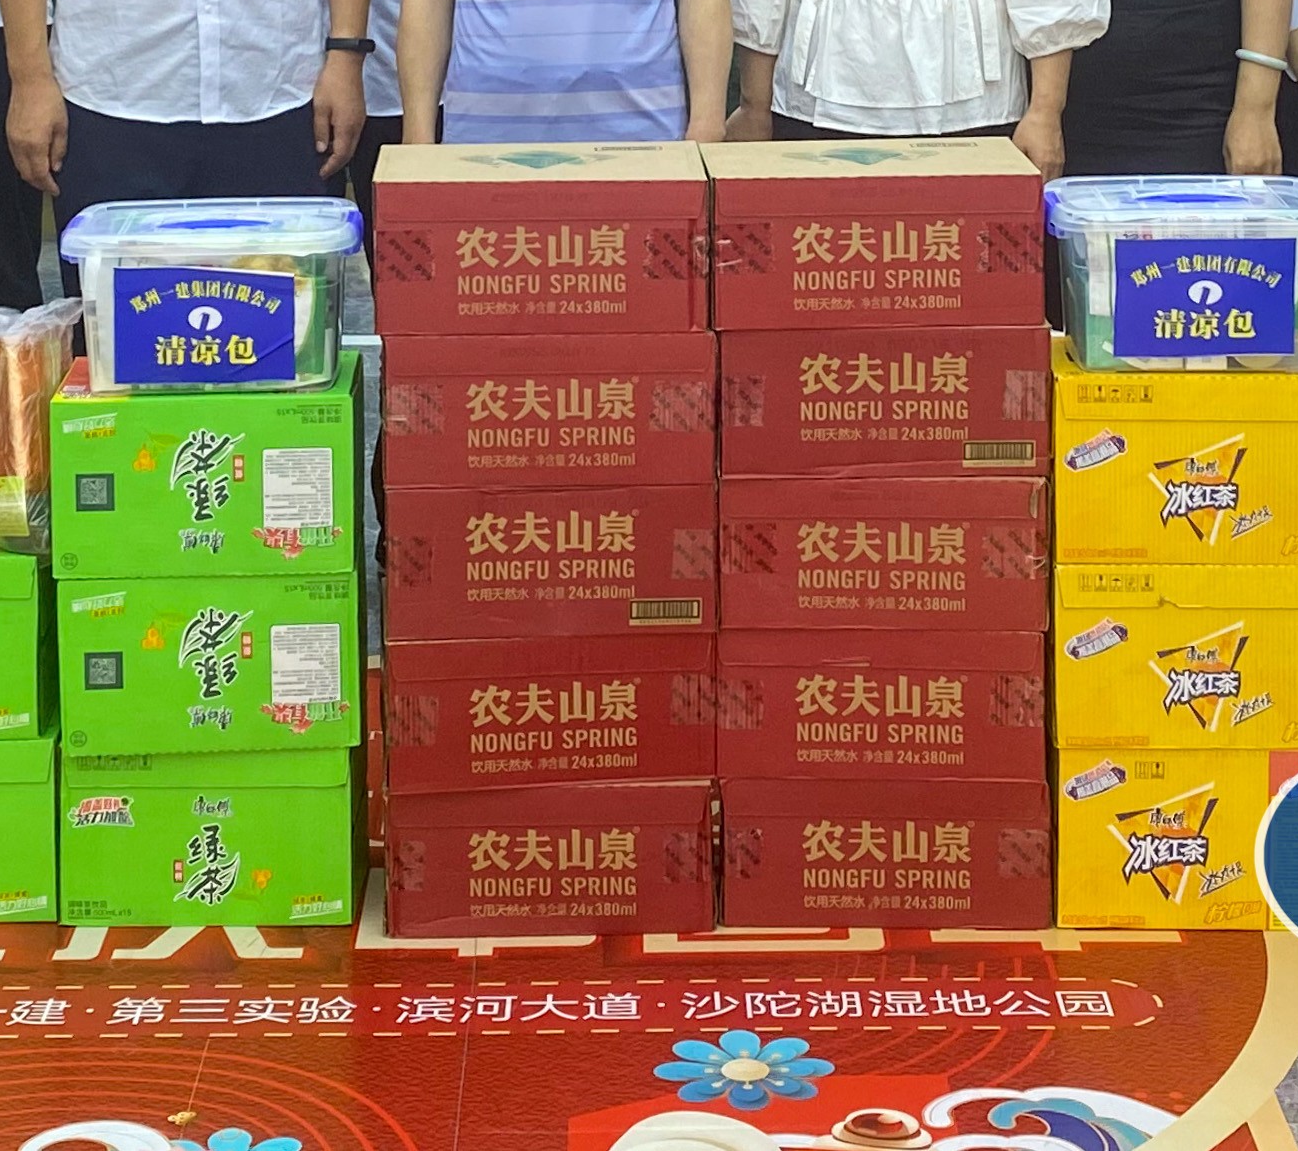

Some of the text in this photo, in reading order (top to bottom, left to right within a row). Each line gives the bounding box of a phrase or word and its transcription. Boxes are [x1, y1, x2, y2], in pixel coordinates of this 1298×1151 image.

[456, 224, 627, 269] 农夫山泉
[792, 220, 962, 264] 农夫山泉
[458, 273, 627, 295] NONGFU SPRING
[794, 269, 961, 290] NONGFU SPRING
[1131, 254, 1282, 288] 郑州一建集团有限公司
[129, 280, 282, 314] 郑州一建集团有限公司
[458, 302, 520, 316] 饮用天然水
[794, 298, 854, 311] 饮用天然水
[1154, 308, 1256, 339] 清凉包
[155, 335, 258, 366] 清凉包
[799, 352, 970, 395] 农夫山泉
[465, 378, 636, 422] 农夫山泉
[801, 400, 968, 421] NONGFU SPRING
[467, 426, 636, 448] NONGFU SPRING
[801, 428, 862, 441] 饮用天然水
[171, 429, 244, 522] 绿茶
[468, 455, 529, 468] 饮用天然水
[1163, 480, 1238, 518] 冰红茶
[465, 510, 636, 554] 农夫山泉
[797, 521, 967, 565] 农夫山泉
[467, 559, 635, 581] NONGFU SPRING
[798, 570, 966, 590] NONGFU SPRING
[467, 587, 529, 601] 饮用天然水
[798, 596, 860, 609] 饮用天然水
[179, 607, 253, 699] 绿茶
[795, 674, 965, 718] 农夫山泉
[1164, 668, 1240, 707] 冰红茶
[469, 681, 638, 727] 农夫山泉
[471, 727, 638, 753] NONGFU SPRING
[797, 722, 964, 744] NONGFU SPRING
[472, 759, 533, 773] 饮用天然水
[797, 749, 857, 763] 饮用天然水
[468, 828, 638, 871] 农夫山泉
[802, 820, 972, 863] 农夫山泉
[1124, 834, 1207, 874] 冰红茶
[174, 824, 240, 907] 绿茶
[804, 869, 971, 889] NONGFU SPRING
[470, 876, 637, 897] NONGFU SPRING
[470, 904, 531, 917] 饮用天然水
[804, 896, 865, 909] 饮用天然水
